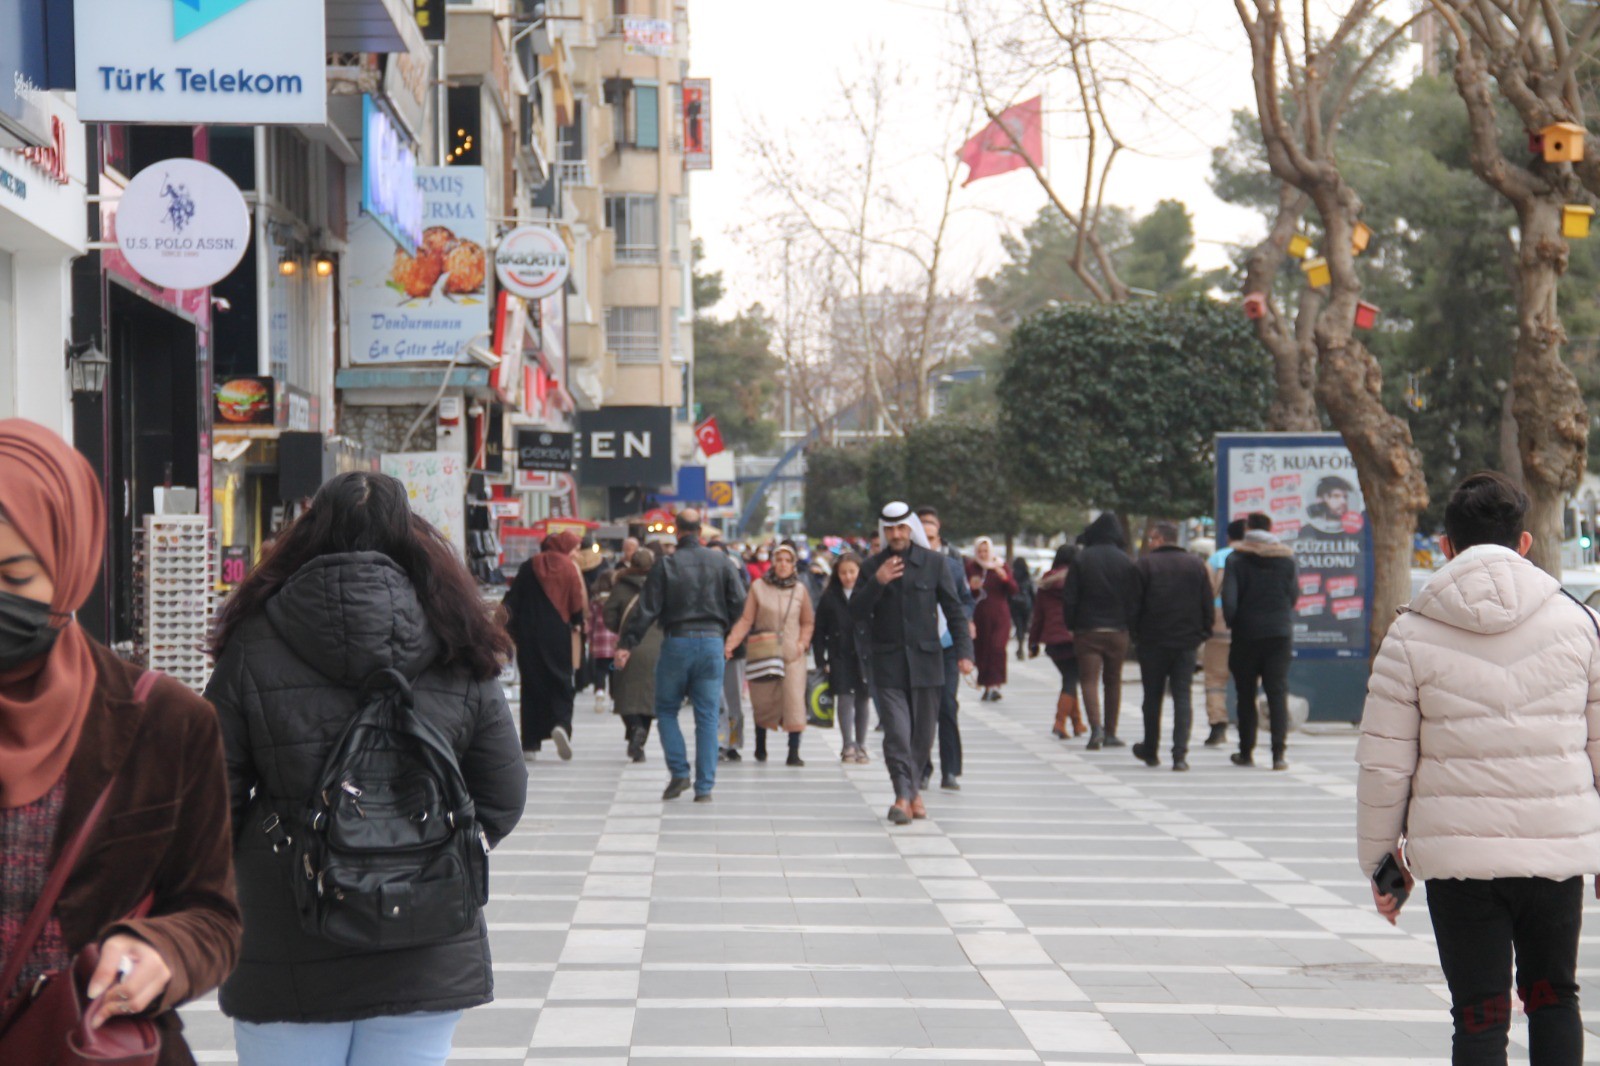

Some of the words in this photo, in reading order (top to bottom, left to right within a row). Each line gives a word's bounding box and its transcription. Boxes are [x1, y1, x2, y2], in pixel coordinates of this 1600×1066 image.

[98, 66, 165, 91] Türk
[176, 68, 302, 93] Telekom
[415, 176, 464, 197] RMIŞ
[125, 238, 152, 250] U.S.
[154, 238, 193, 250] POLO
[368, 340, 389, 358] En
[1294, 539, 1361, 554] GÜZELLİK
[1299, 555, 1356, 568] SALONU
